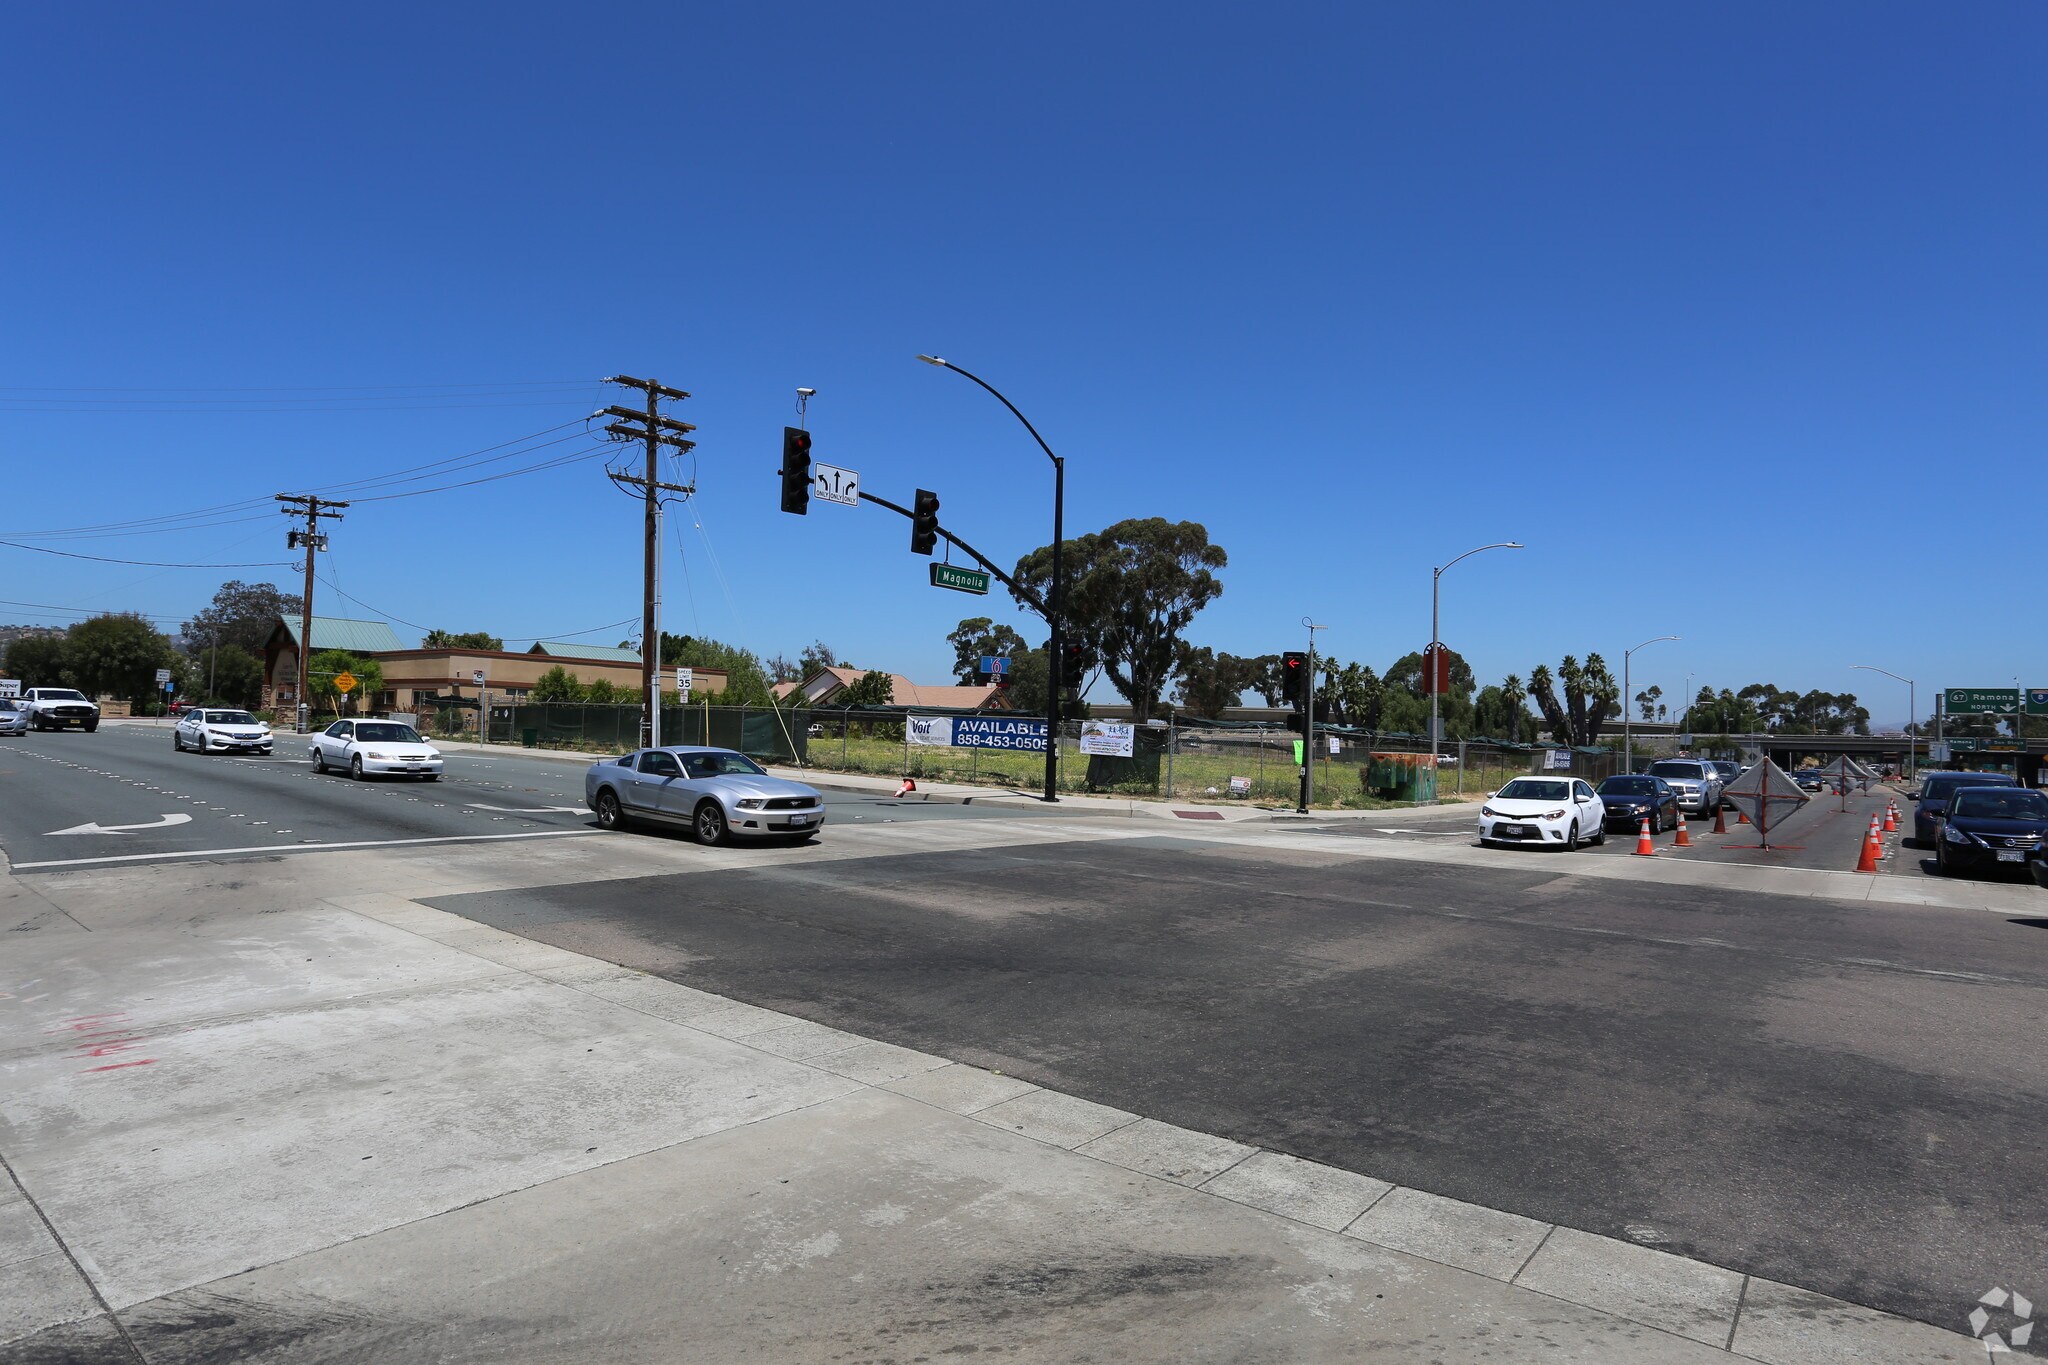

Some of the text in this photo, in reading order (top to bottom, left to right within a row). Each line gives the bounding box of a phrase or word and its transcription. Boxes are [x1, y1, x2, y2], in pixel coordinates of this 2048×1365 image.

[816, 490, 828, 498] ONLY
[943, 571, 983, 587] Magnolia
[991, 658, 1002, 673] 6
[678, 679, 691, 687] 35
[912, 720, 931, 734] Voit
[958, 720, 1048, 736] AVAILABLE
[957, 733, 1048, 750] 858-453-0505
